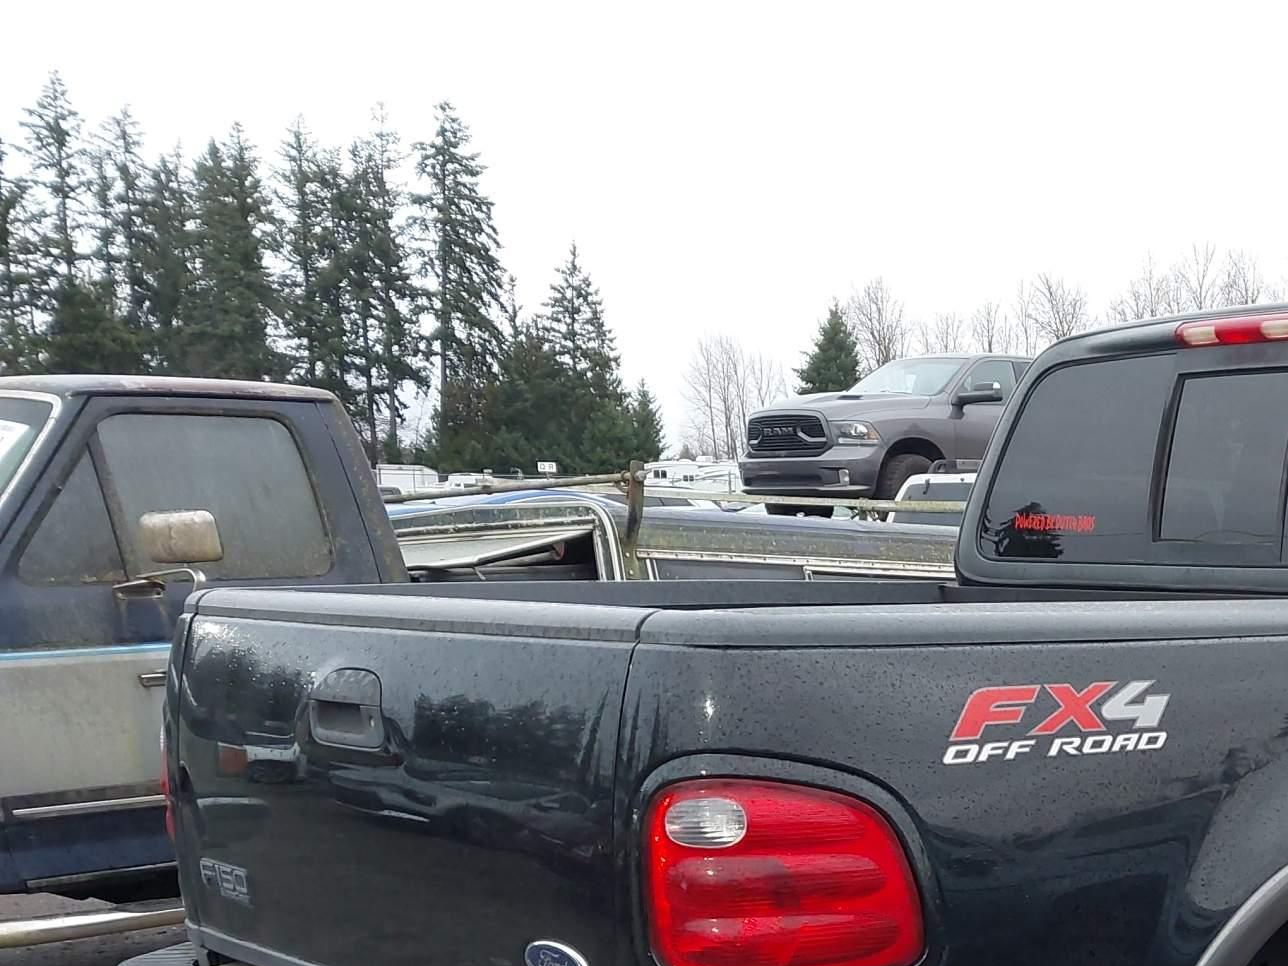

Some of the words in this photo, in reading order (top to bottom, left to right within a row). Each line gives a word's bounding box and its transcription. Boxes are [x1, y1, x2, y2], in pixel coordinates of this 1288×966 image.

[763, 427, 793, 436] RAM
[949, 680, 1170, 741] FX4
[943, 739, 1036, 765] OFF
[1047, 731, 1167, 757] ROAD
